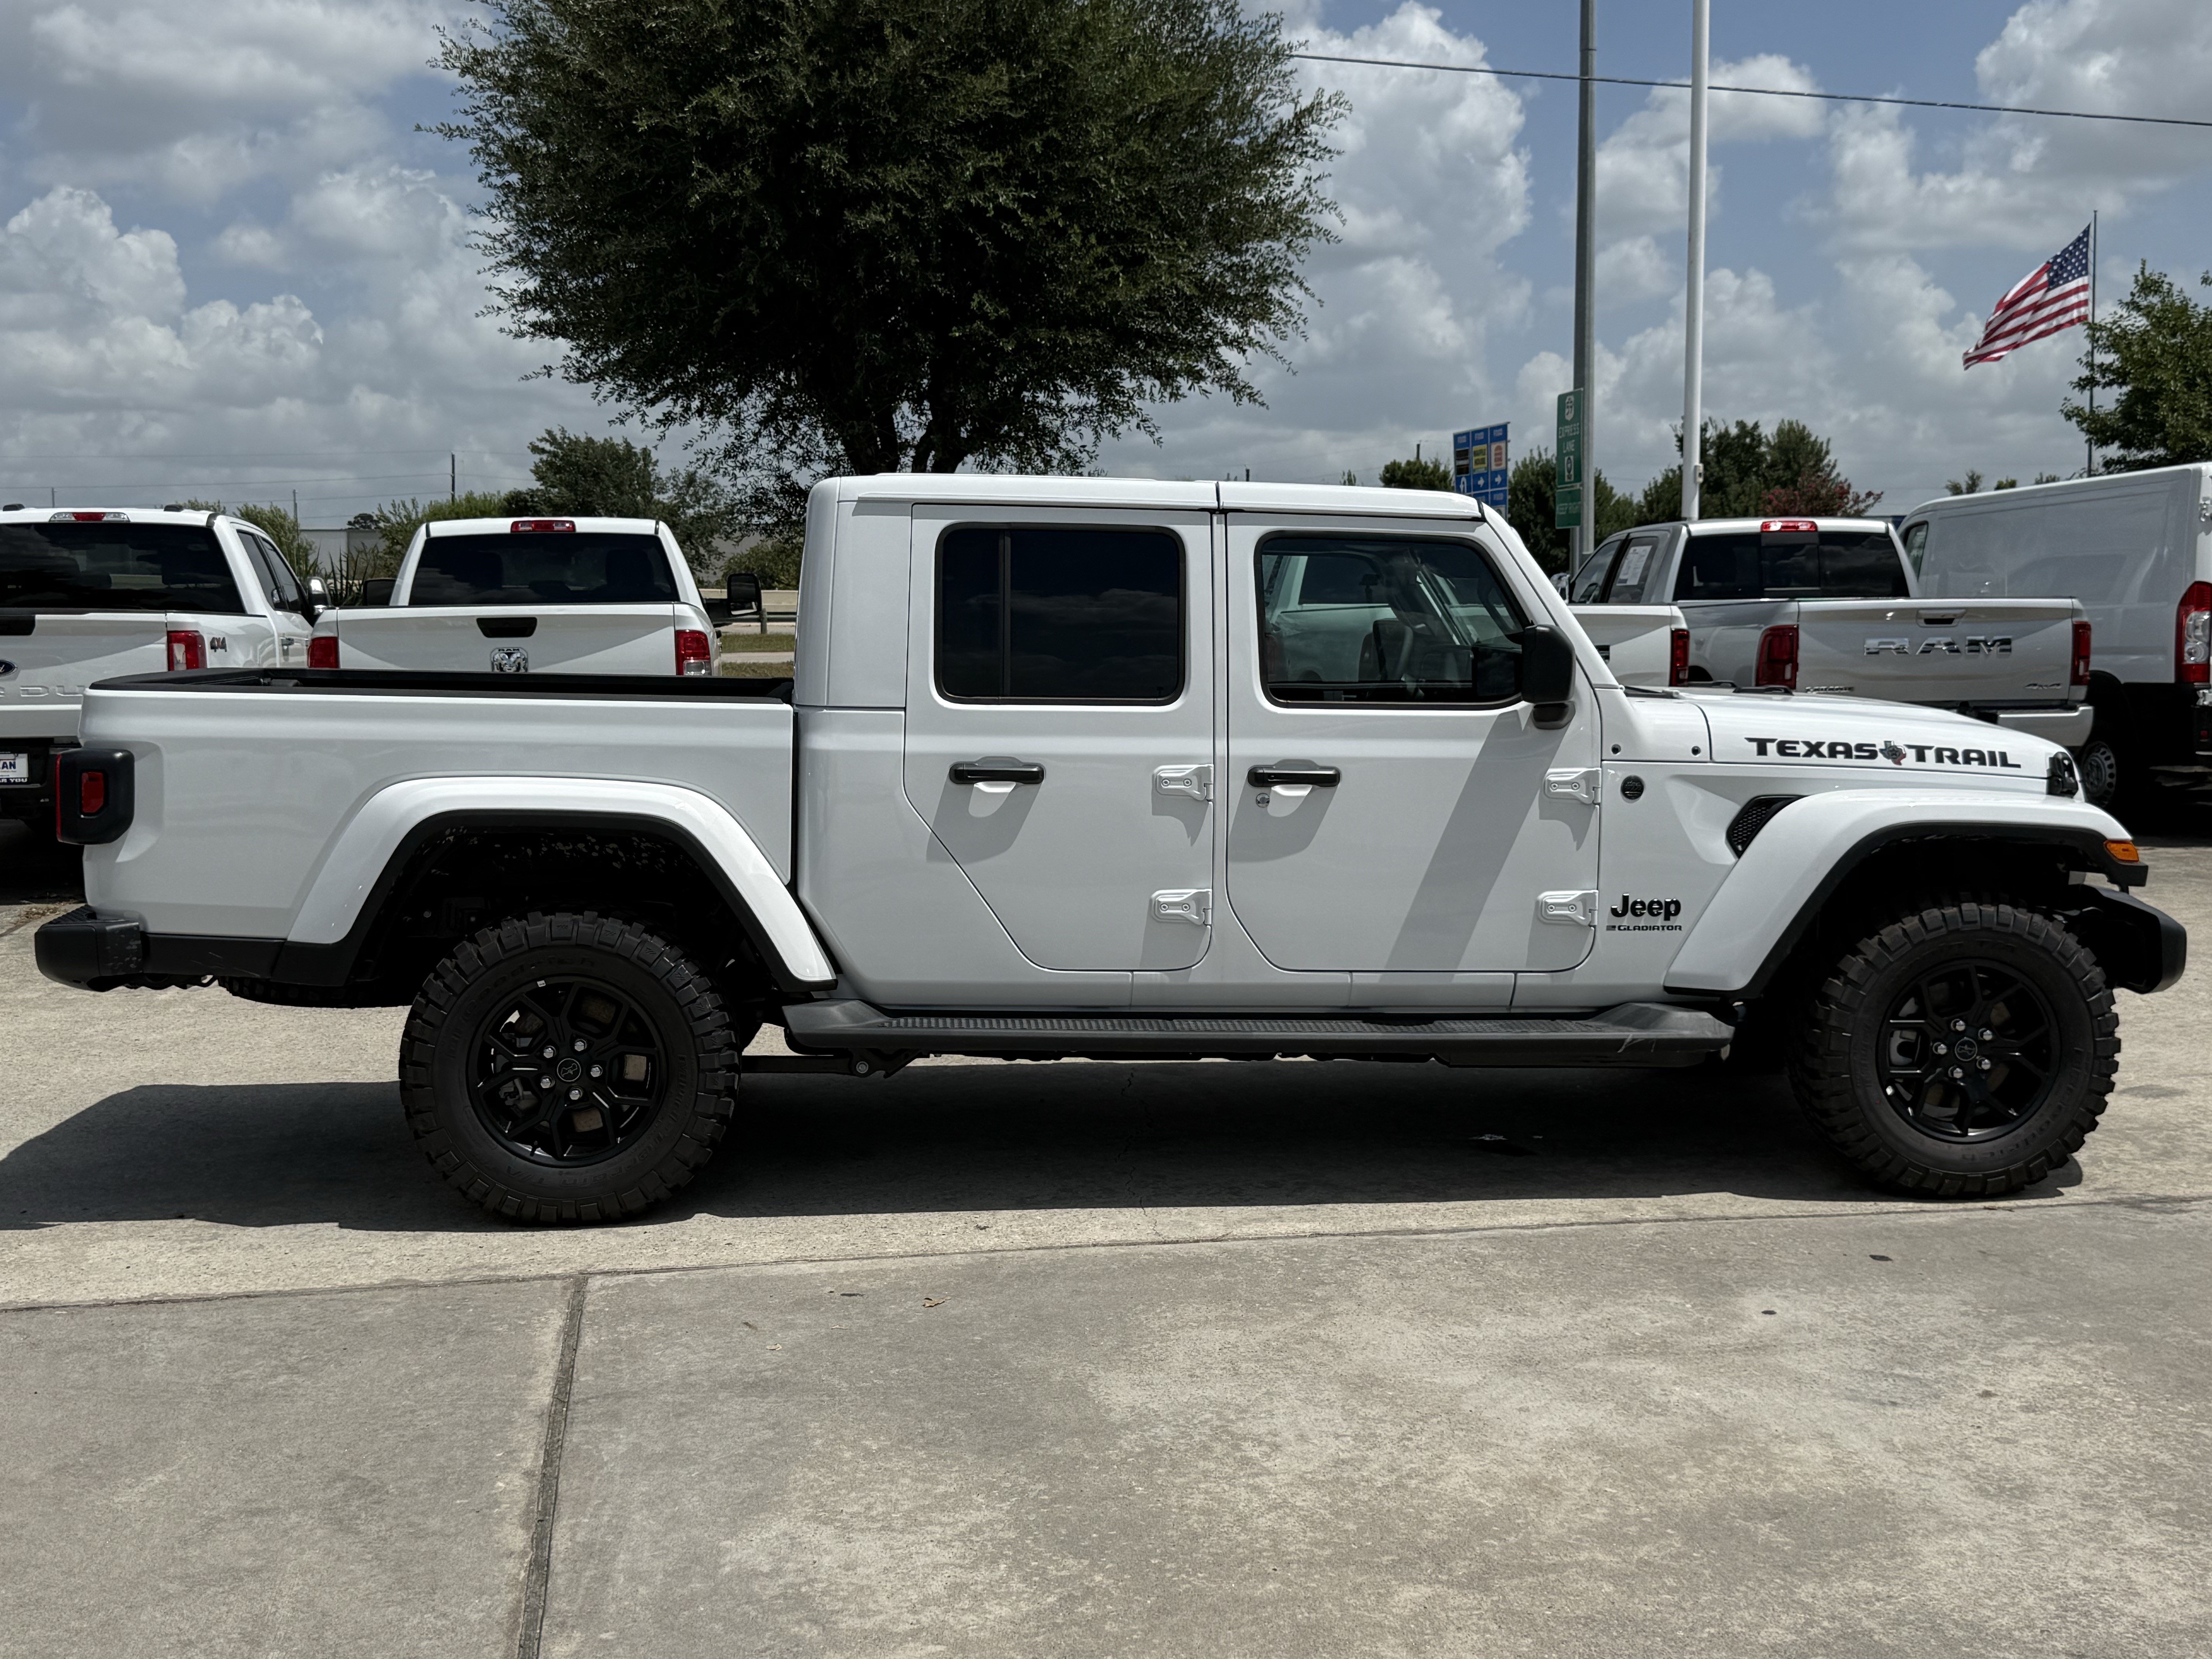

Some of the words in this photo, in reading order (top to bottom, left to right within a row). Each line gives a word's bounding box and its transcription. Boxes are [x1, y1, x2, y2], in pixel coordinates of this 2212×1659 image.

[1558, 422, 1580, 439] EXPRESS
[1563, 440, 1575, 453] LANE
[1864, 635, 2013, 656] RAM
[20, 685, 85, 697] DU
[1744, 737, 1878, 760] TEXAS
[1903, 744, 2021, 769] TRAIL
[1611, 893, 1681, 921] Jeep
